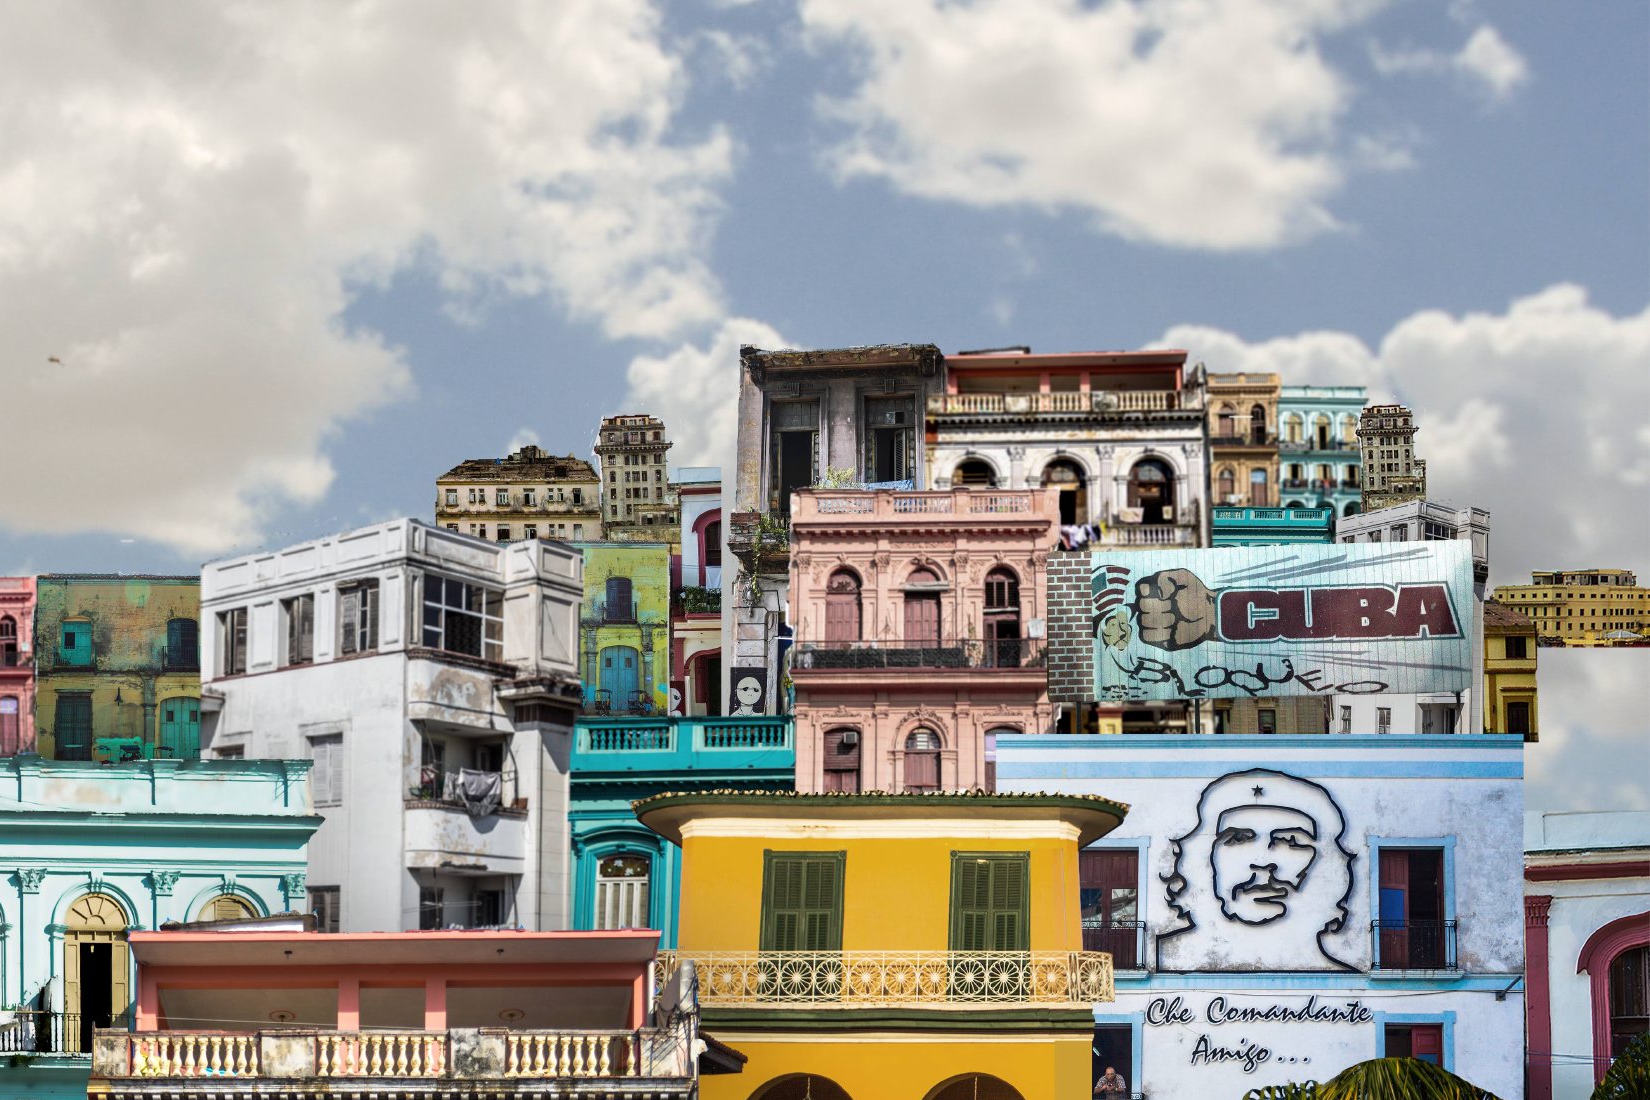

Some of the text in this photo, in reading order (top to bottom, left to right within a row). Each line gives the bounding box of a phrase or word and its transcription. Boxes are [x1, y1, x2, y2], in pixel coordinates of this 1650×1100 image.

[1217, 582, 1464, 643] CUBA
[1129, 656, 1388, 697] BLOQUEO
[1146, 993, 1373, 1026] Che Comandante
[1191, 1034, 1270, 1072] Amigo
